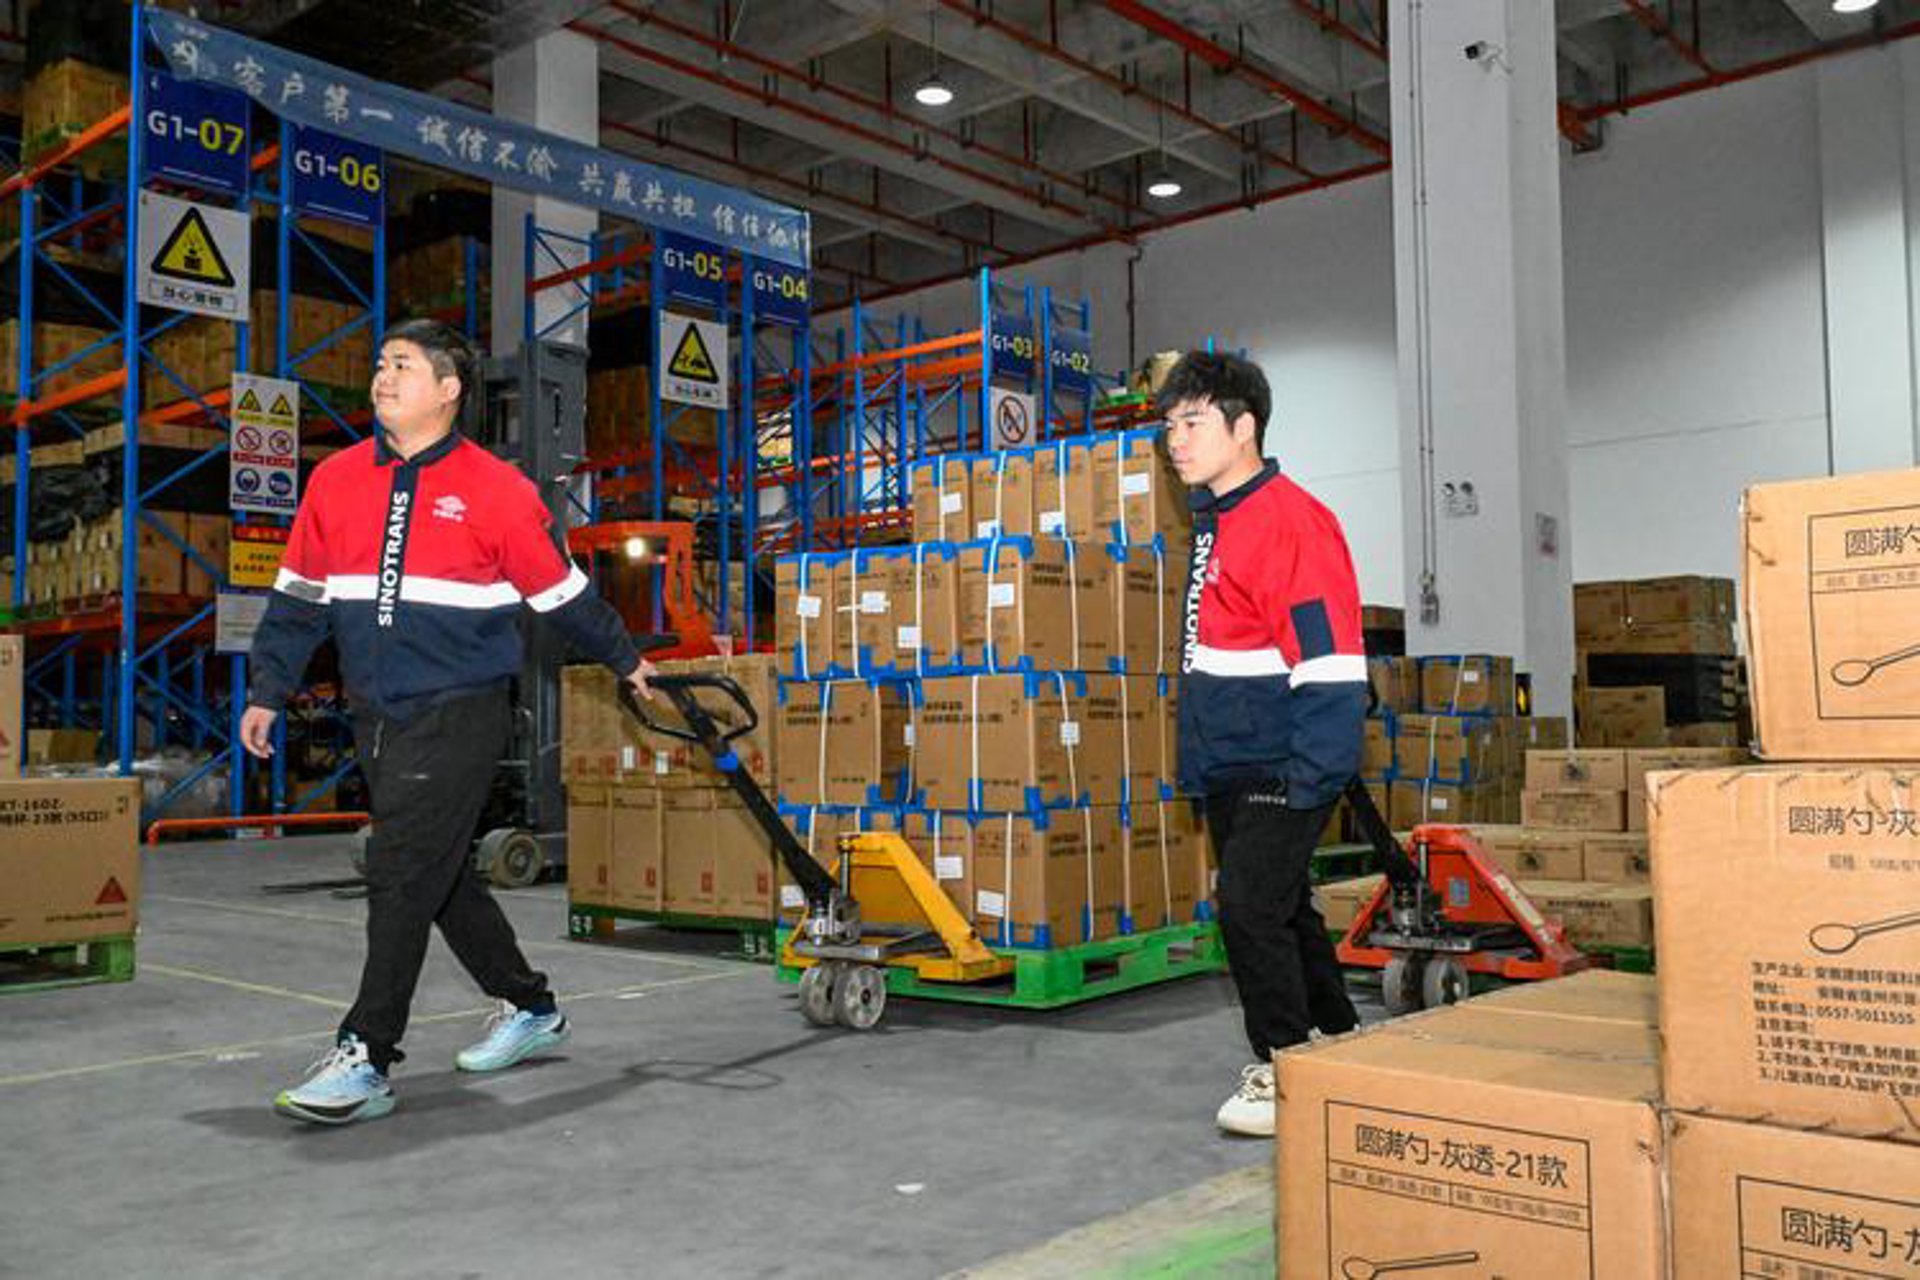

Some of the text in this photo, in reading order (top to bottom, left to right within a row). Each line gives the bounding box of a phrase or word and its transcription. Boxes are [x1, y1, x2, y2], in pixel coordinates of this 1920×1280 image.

[233, 56, 393, 123] 客户第一
[147, 109, 245, 155] G1-07
[294, 150, 381, 193] G1-06
[663, 247, 723, 283] G1-05
[753, 271, 807, 301] G1-04
[992, 334, 1033, 359] G1-03
[1051, 349, 1089, 374] G1-02
[378, 491, 410, 627] SINOTRANS
[1355, 1123, 1568, 1189] 圆满勺-灰透-21款
